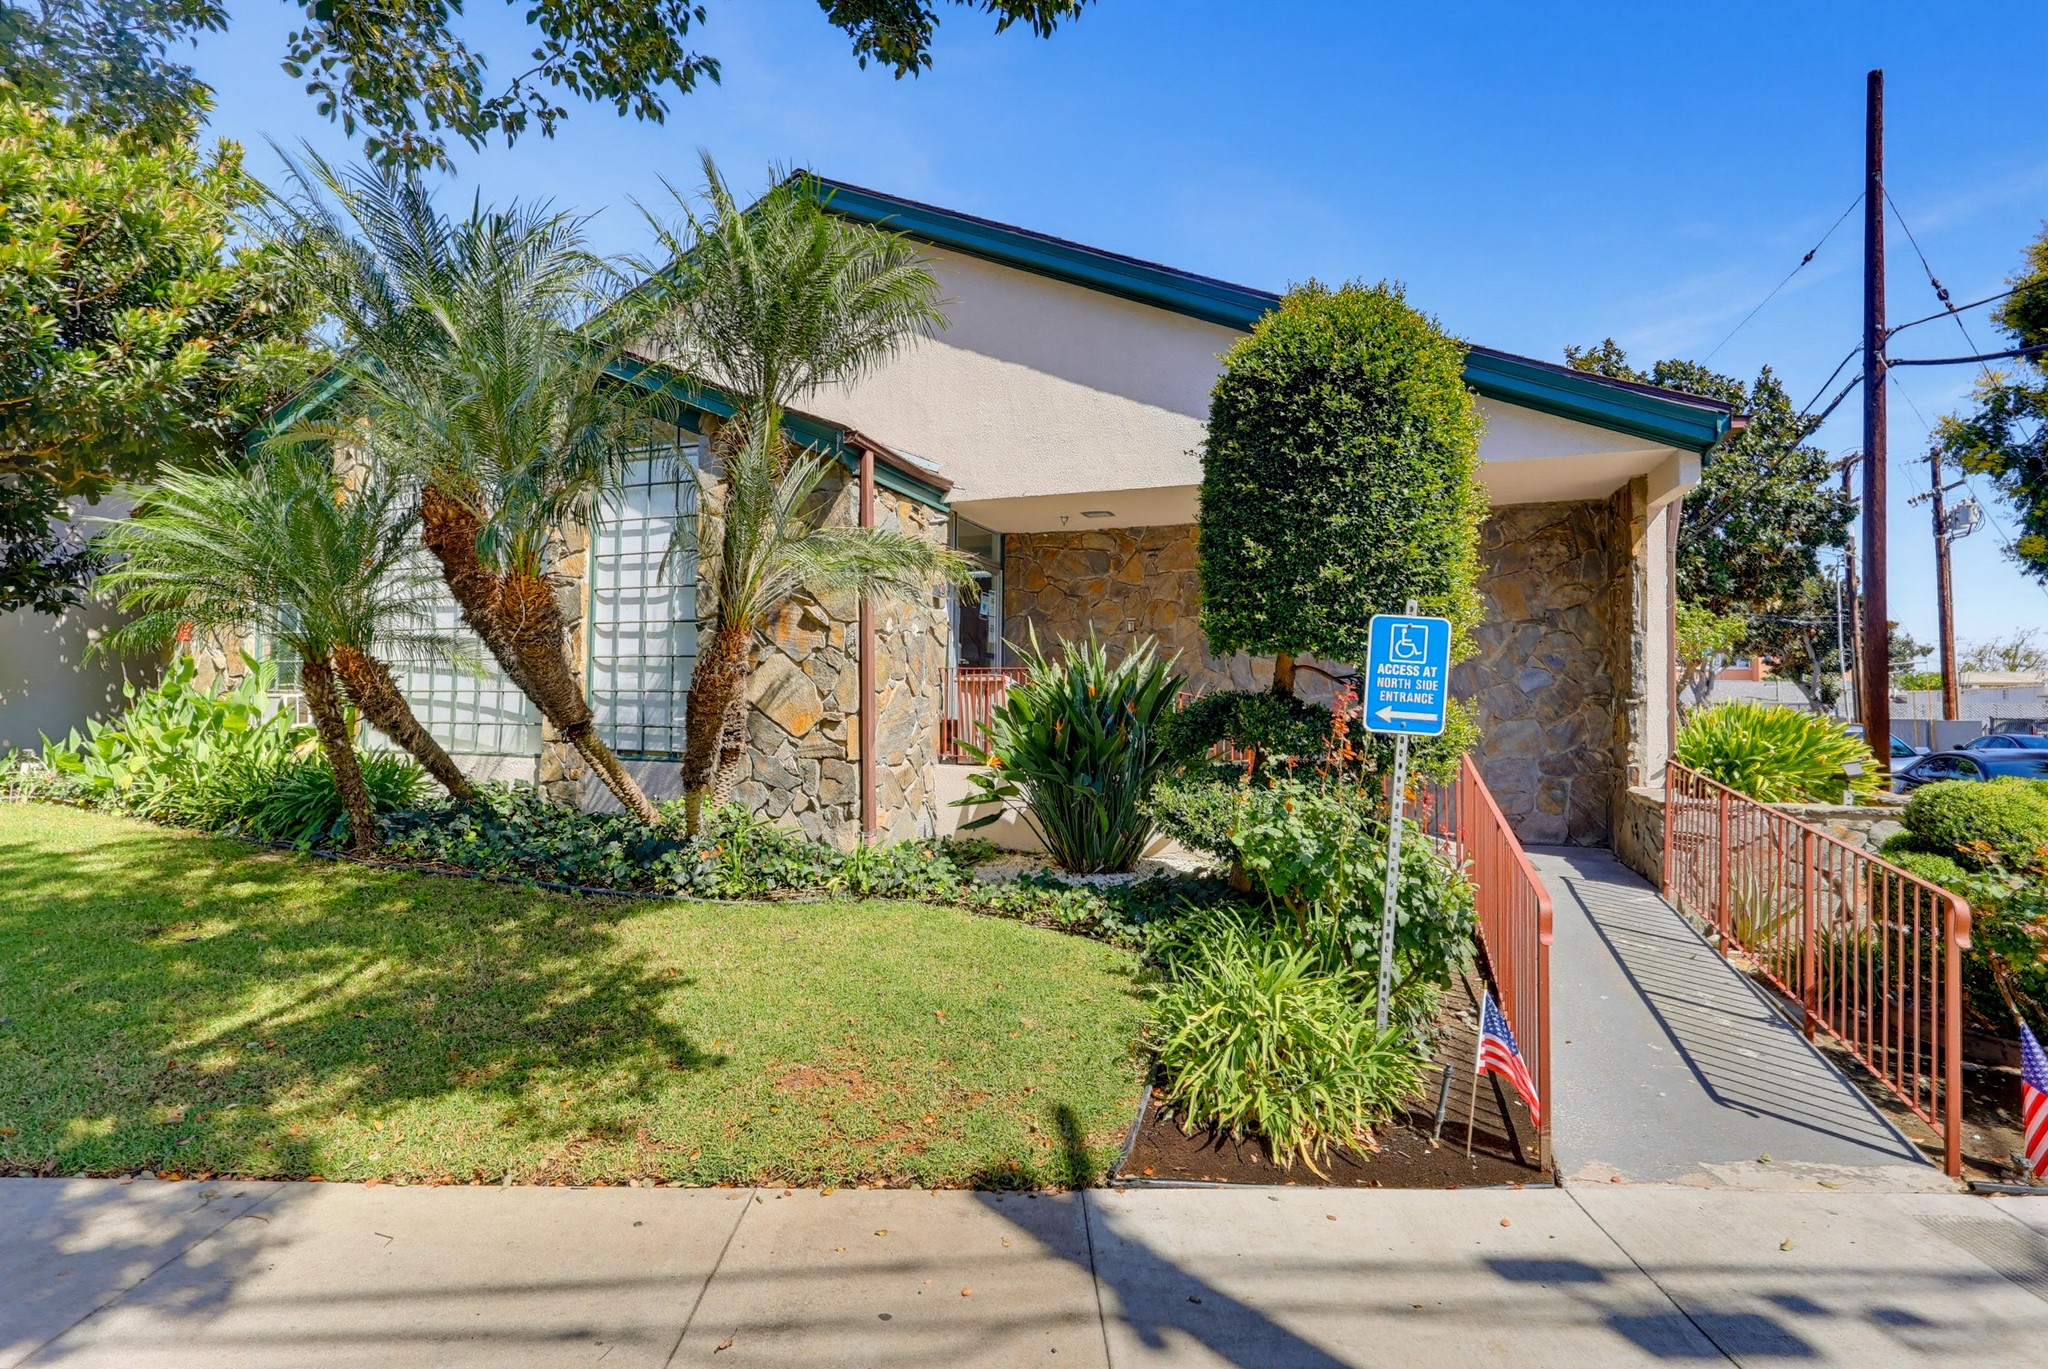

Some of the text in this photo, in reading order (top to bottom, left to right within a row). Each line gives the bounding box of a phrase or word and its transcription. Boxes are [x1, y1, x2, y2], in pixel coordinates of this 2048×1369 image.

[1377, 663, 1438, 677] ACCESS AT
[1377, 677, 1438, 690] NORTH SIDE
[1380, 691, 1434, 704] ENTRANCE
